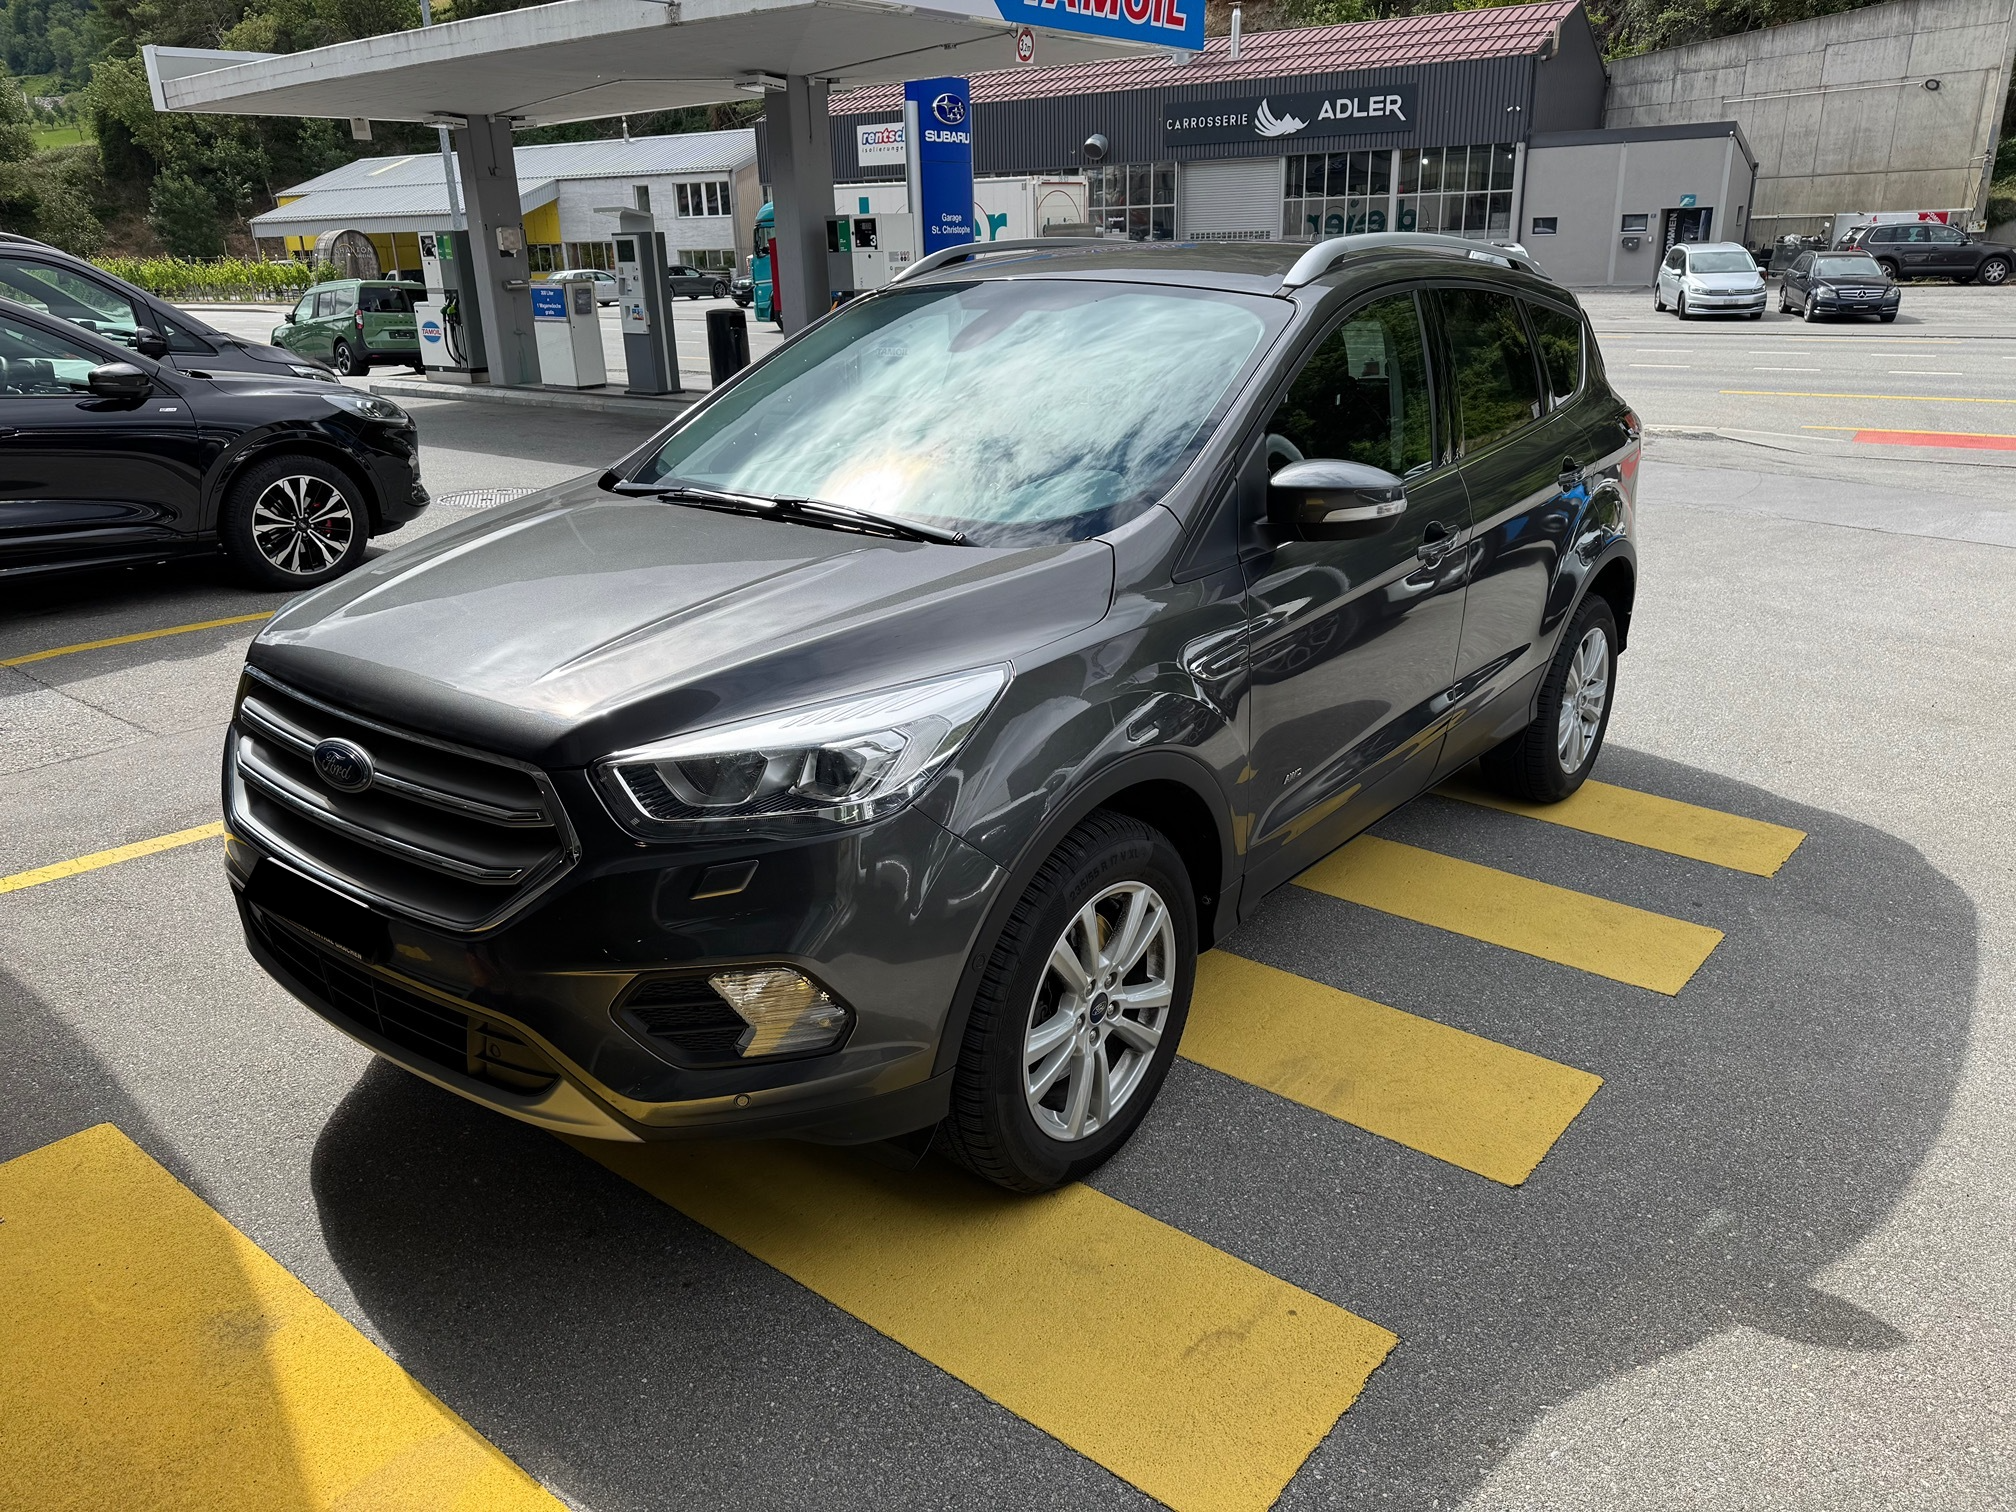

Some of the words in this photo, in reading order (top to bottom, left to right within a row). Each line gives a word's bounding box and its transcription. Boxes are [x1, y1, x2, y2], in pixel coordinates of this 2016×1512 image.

[1024, 0, 1187, 31] MOIL
[1166, 113, 1248, 130] CARROSSERIE
[1317, 94, 1406, 121] ADLER
[925, 130, 970, 144] SUBARU
[931, 225, 941, 234] St.
[942, 224, 971, 235] Christophe
[941, 213, 962, 222] Garage
[870, 235, 876, 246] 3
[1664, 214, 1678, 256] OMMEN
[321, 750, 353, 780] Ford
[1069, 867, 1100, 902] 235/55
